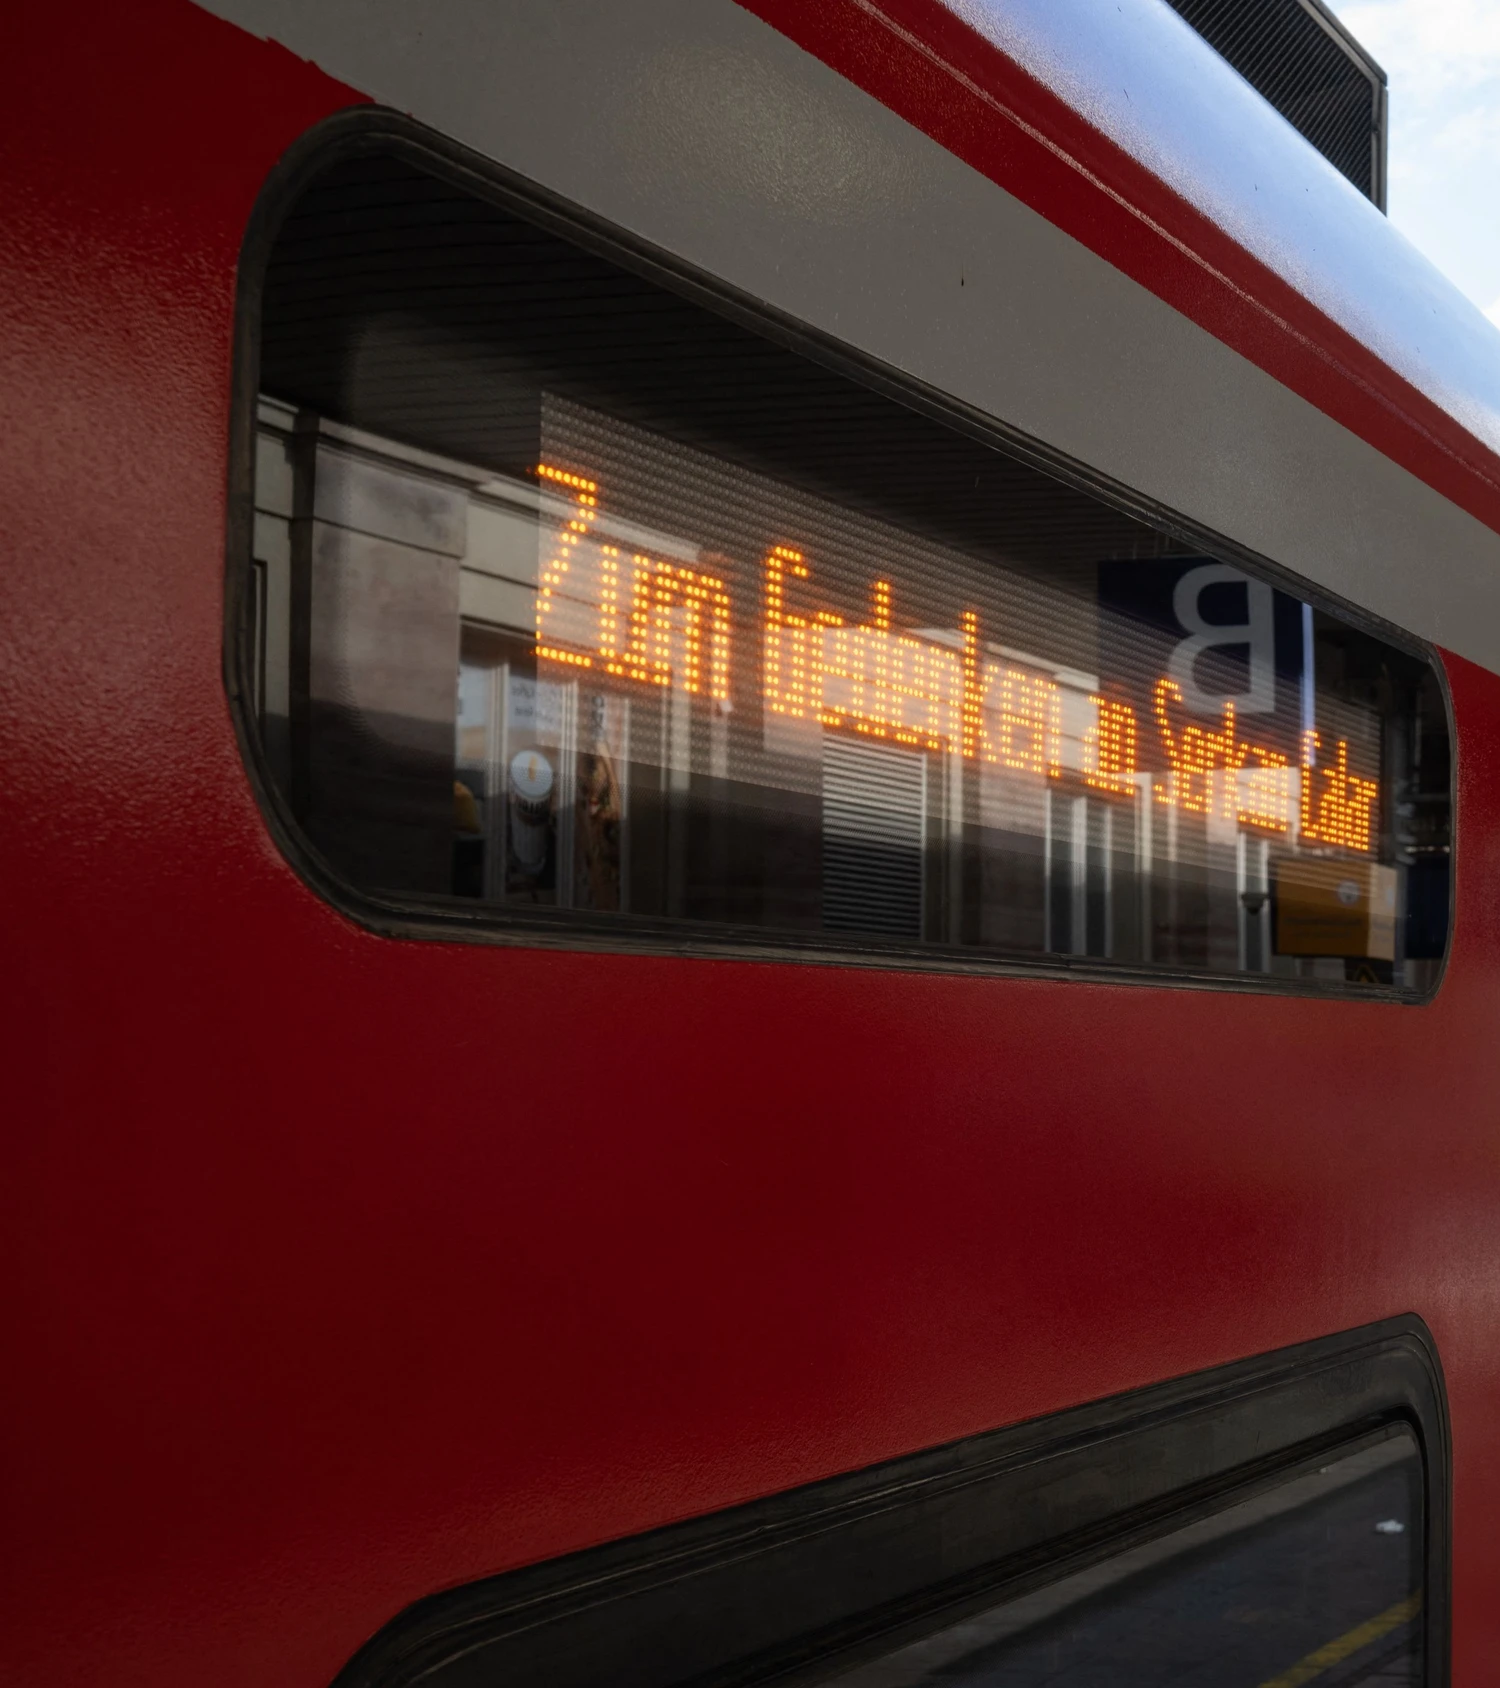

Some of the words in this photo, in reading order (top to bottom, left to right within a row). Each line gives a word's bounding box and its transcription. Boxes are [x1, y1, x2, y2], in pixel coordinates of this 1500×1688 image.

[535, 464, 732, 700] Zum
[763, 546, 1062, 778] Gedenken
[1082, 696, 1138, 796] an
[1153, 679, 1289, 832] Serkan
